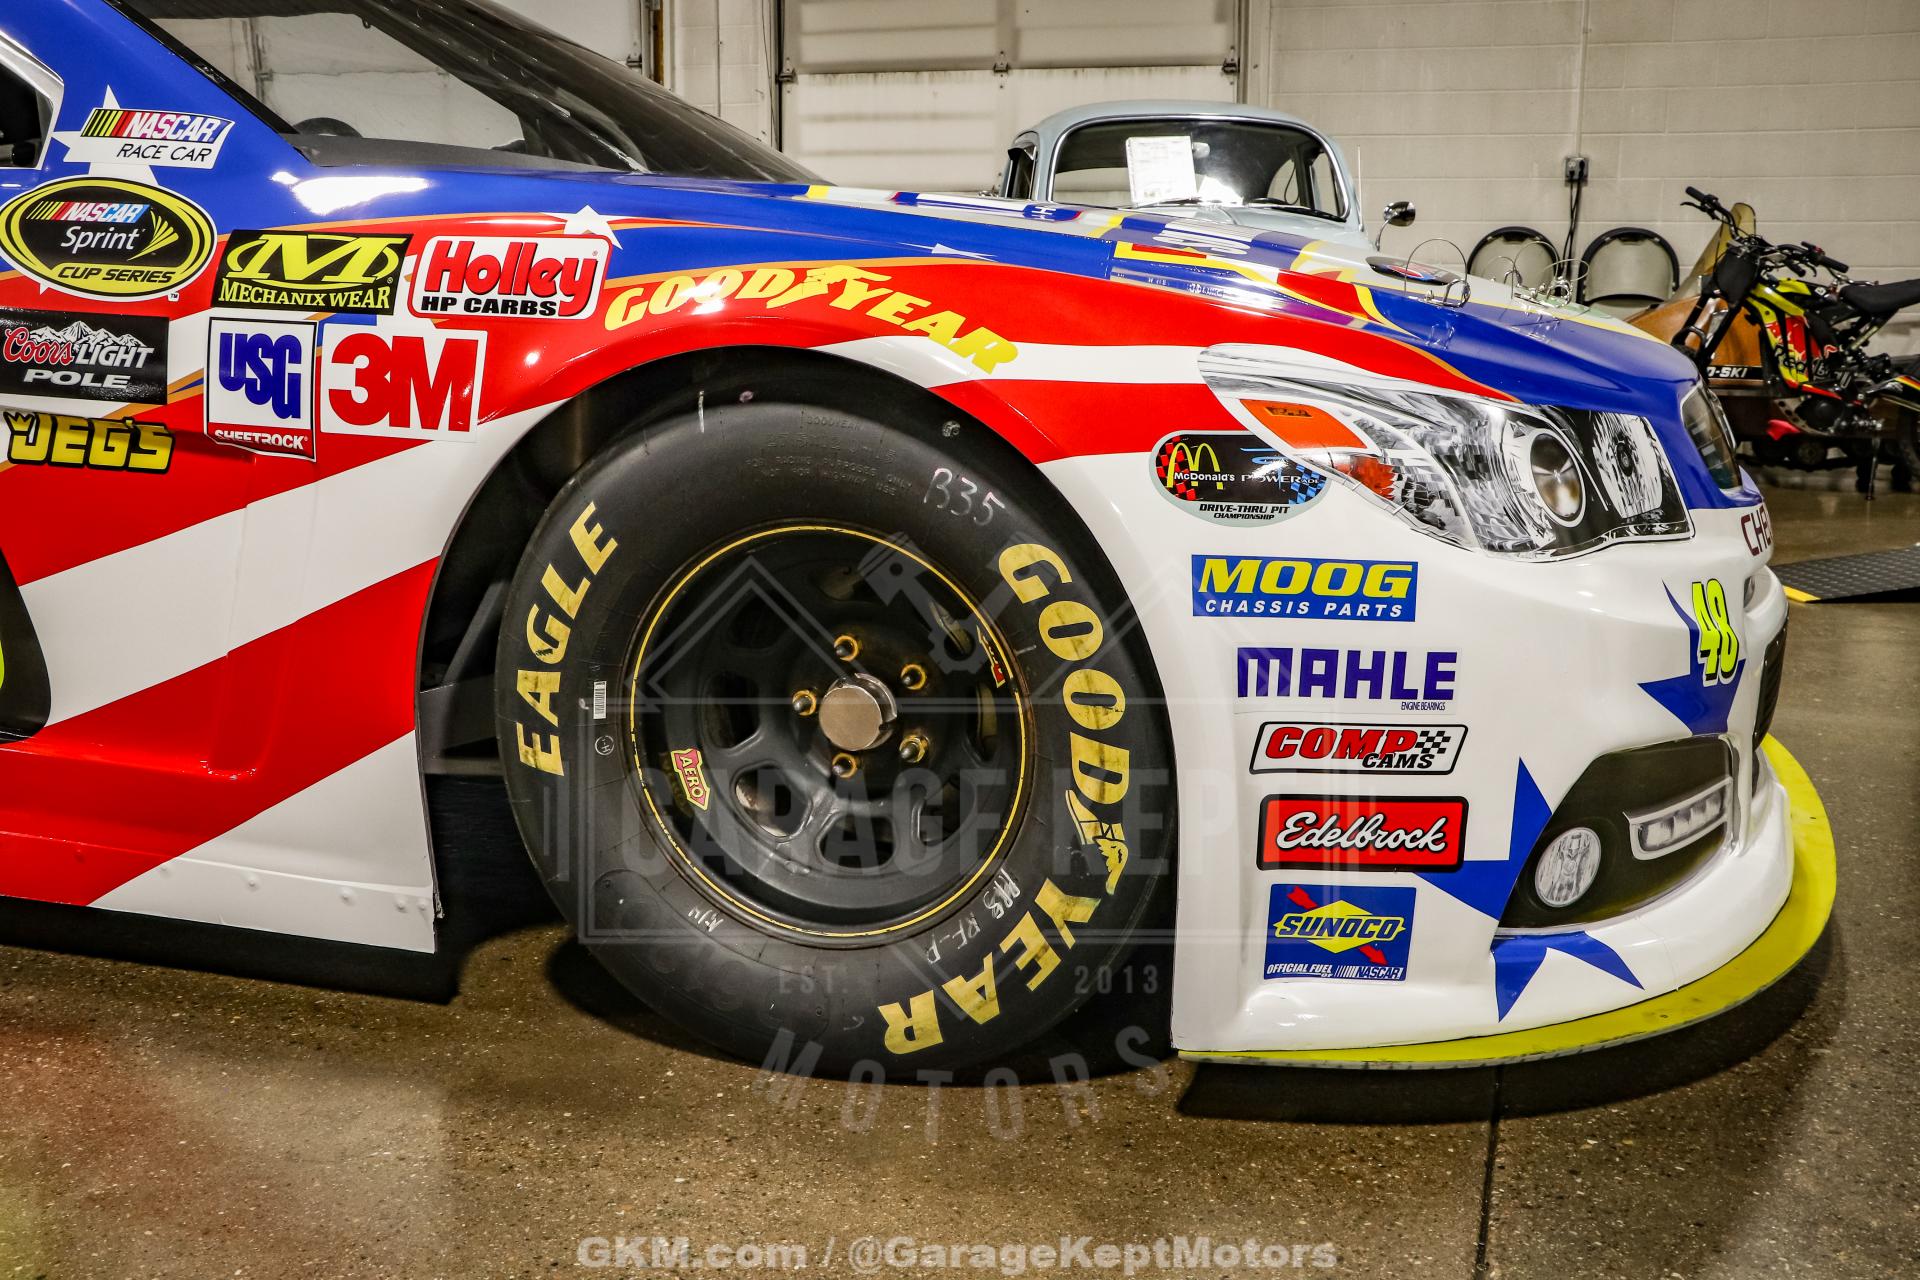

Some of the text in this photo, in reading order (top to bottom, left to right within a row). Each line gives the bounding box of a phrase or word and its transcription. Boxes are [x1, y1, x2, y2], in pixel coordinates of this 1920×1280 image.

[122, 111, 220, 142] NASCAR
[116, 143, 212, 162] RACE CAR
[60, 202, 142, 222] NASCAR
[60, 225, 141, 254] Sprint
[57, 266, 176, 284] CUP SERIES
[424, 239, 599, 317] Holley
[218, 278, 390, 309] MECHANIX WEAR
[420, 295, 557, 316] HP CARBS
[3, 326, 155, 369] Coors LIGHT
[23, 368, 131, 389] POLE
[218, 332, 302, 419] USG
[328, 332, 479, 433] 3M
[5, 412, 175, 473] JEG'S
[214, 429, 304, 450] SHEETROCK
[1174, 472, 1235, 482] McDonald's
[923, 467, 1005, 526] B35
[1199, 503, 1291, 515] DRIVE-THRU PIT
[1213, 512, 1275, 521] CHAMPIONSHIP
[1198, 558, 1414, 599] MOOG
[1205, 599, 1403, 618] CHASSIS PARTS
[516, 500, 619, 777] EAGLE
[1691, 578, 1740, 682] 48
[1237, 647, 1458, 701] MAHLE
[1400, 701, 1446, 711] ENGINE BEARINGS
[1265, 726, 1419, 760] COMP
[1361, 752, 1435, 769] CAMS
[679, 755, 706, 799] AERO
[1275, 810, 1449, 852] Edelbrock
[1278, 914, 1401, 940] SUNOCO
[1266, 963, 1333, 975] OFFICIAL FUEL
[1358, 966, 1404, 980] NASCAR
